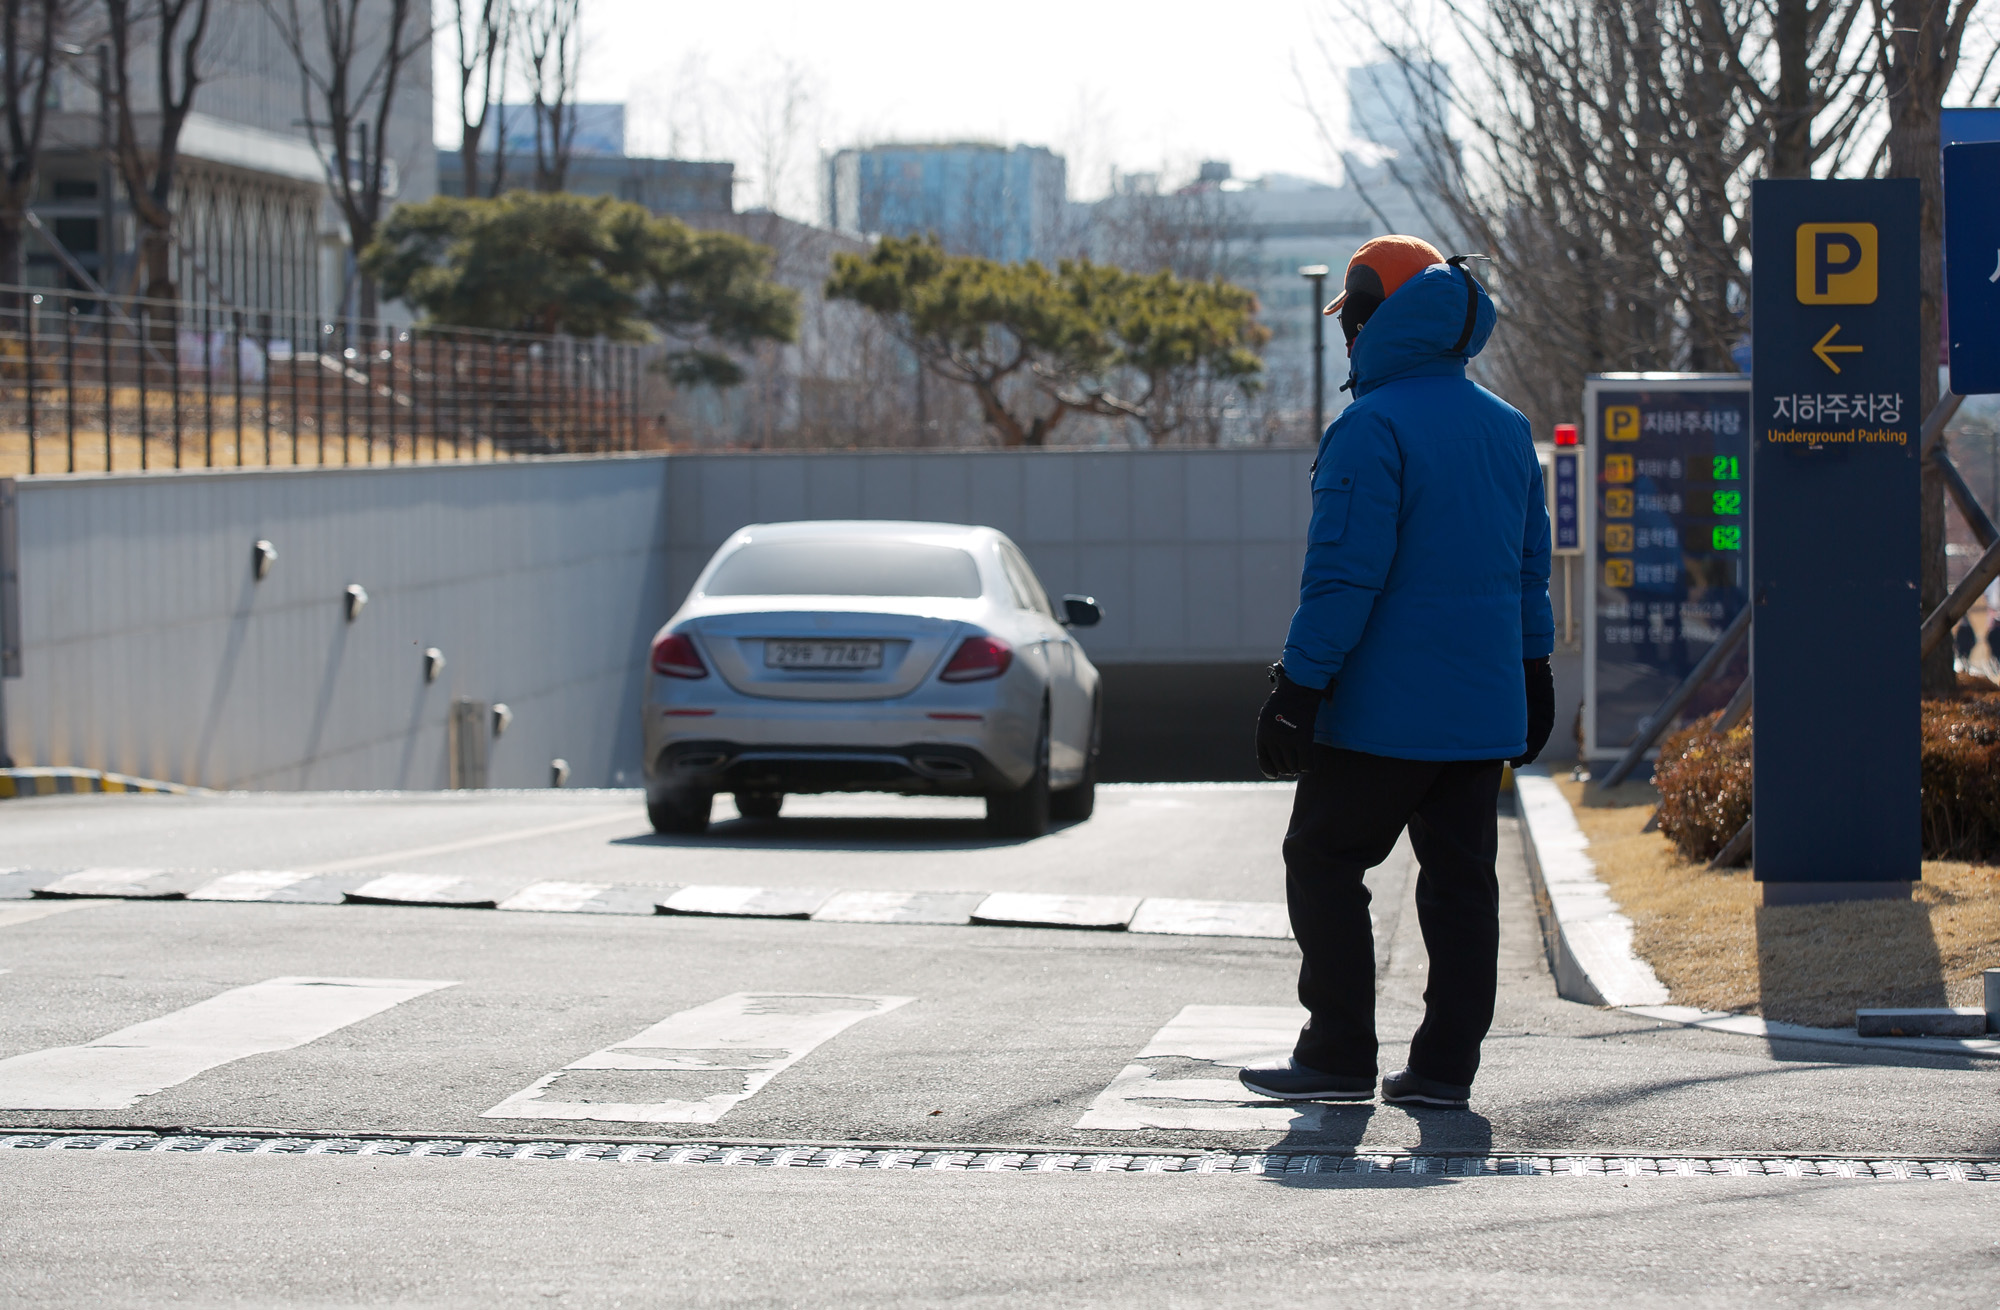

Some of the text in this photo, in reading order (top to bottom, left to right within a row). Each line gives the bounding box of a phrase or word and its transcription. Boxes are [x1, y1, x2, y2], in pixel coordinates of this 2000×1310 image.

[1815, 232, 1862, 295] P
[1773, 393, 1903, 424] 지하주차장
[1644, 410, 1740, 435] 지하주차장
[1768, 428, 1907, 445] Underground Parking
[1712, 455, 1740, 480] 21
[1712, 489, 1741, 515] 32
[1712, 524, 1741, 551] 62
